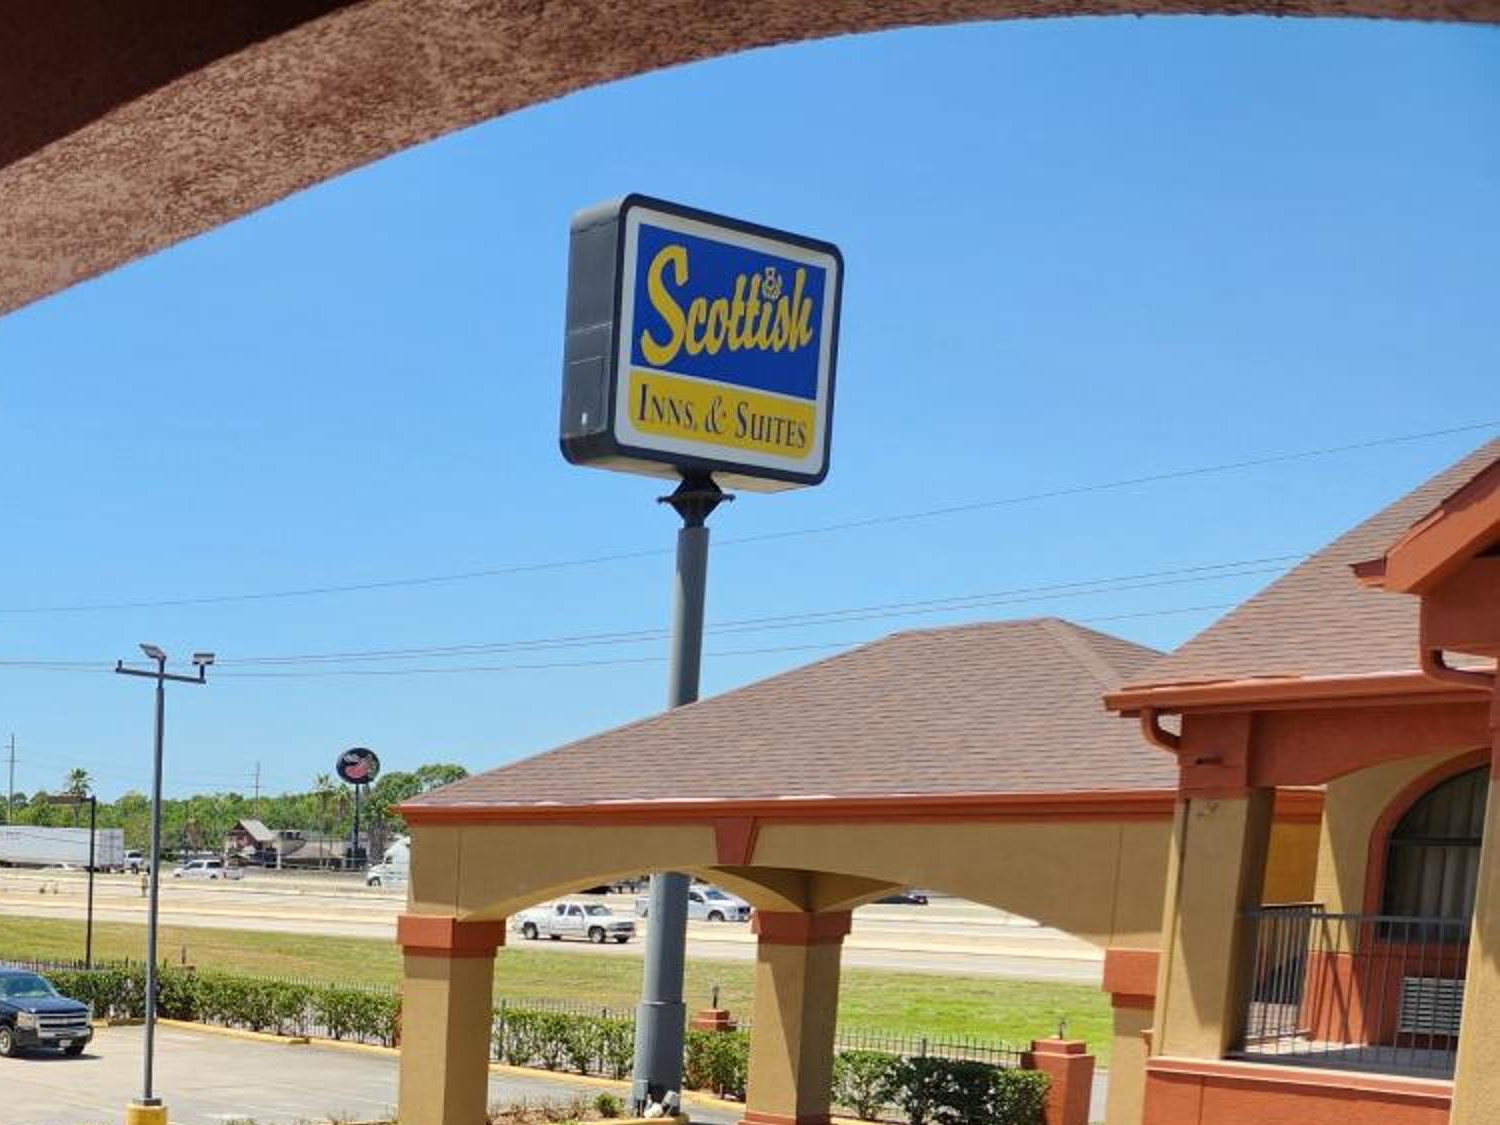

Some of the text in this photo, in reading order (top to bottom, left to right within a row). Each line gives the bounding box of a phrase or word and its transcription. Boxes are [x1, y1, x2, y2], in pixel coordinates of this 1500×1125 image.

[641, 244, 813, 366] Scottish
[705, 396, 728, 435] &
[736, 401, 808, 449] SUITES
